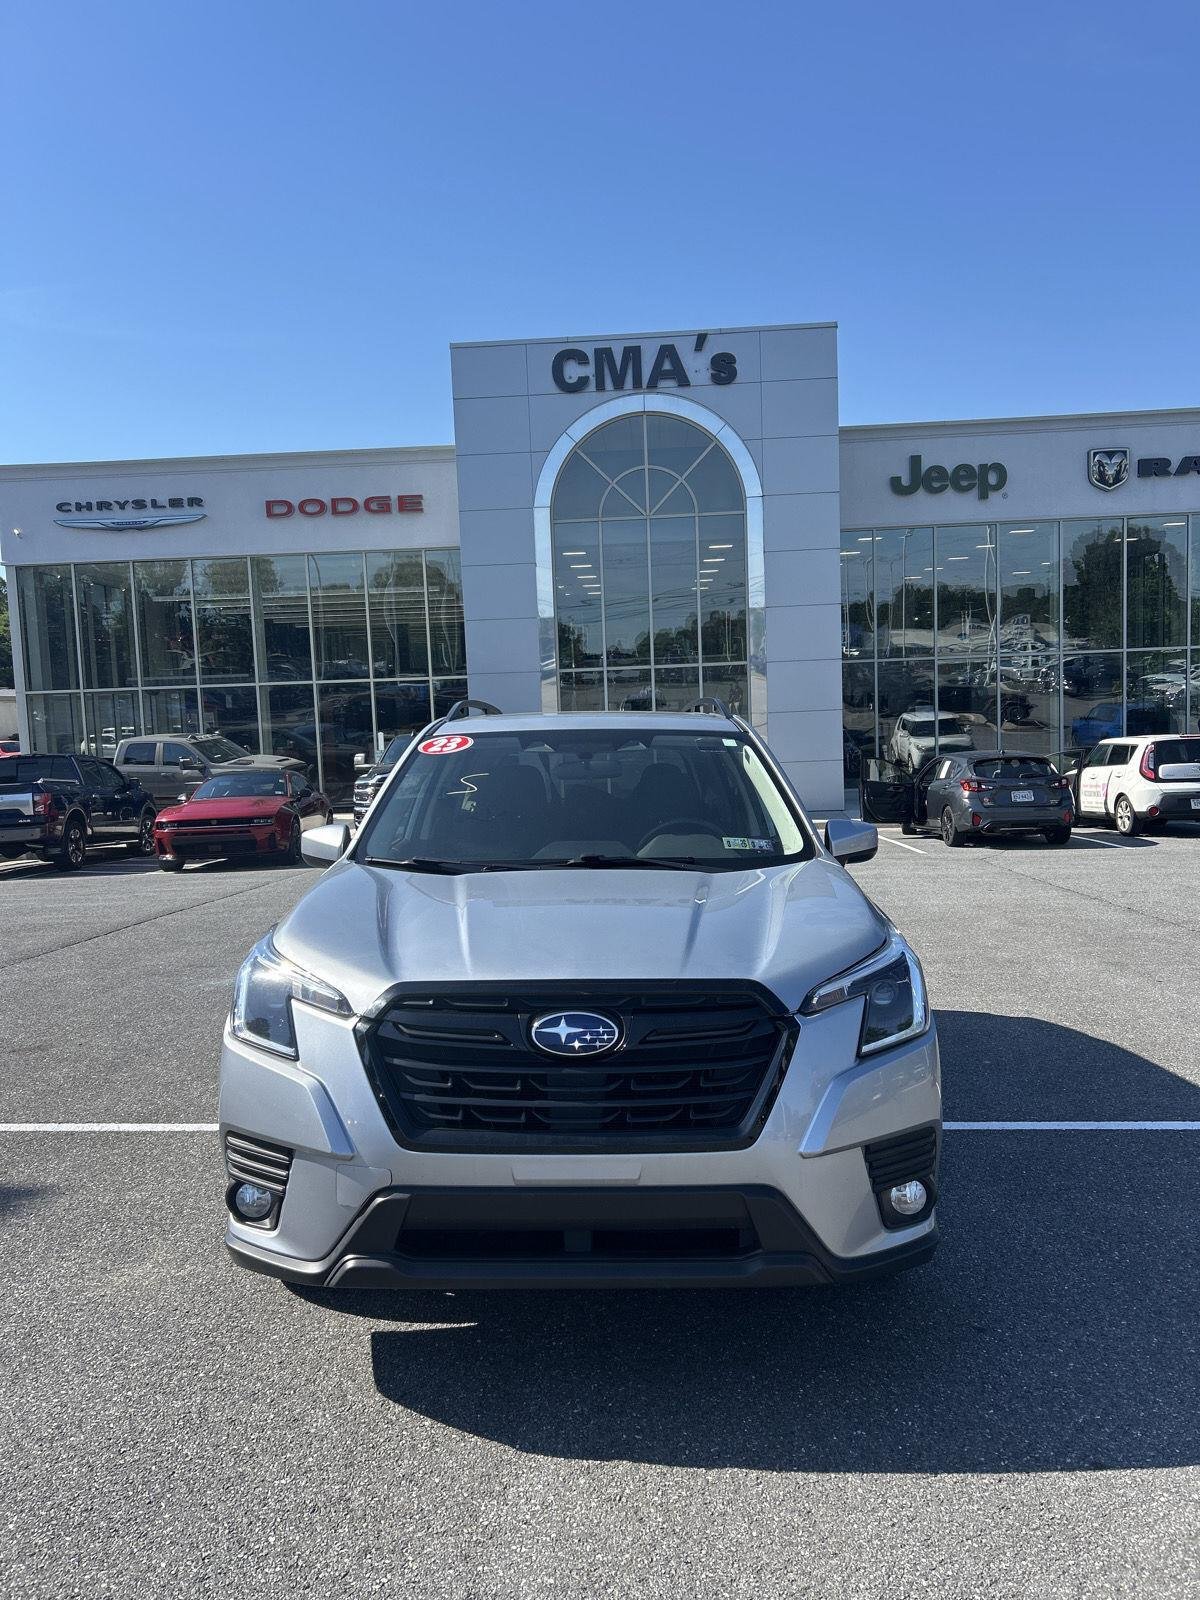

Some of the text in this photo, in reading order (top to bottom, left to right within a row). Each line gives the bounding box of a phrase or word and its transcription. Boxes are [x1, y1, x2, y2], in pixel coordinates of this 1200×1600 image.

[551, 333, 738, 393] CMA's
[889, 454, 1008, 500] Jeep
[55, 496, 204, 513] CHRYSLER
[265, 494, 424, 519] DODGE
[427, 736, 462, 752] 23
